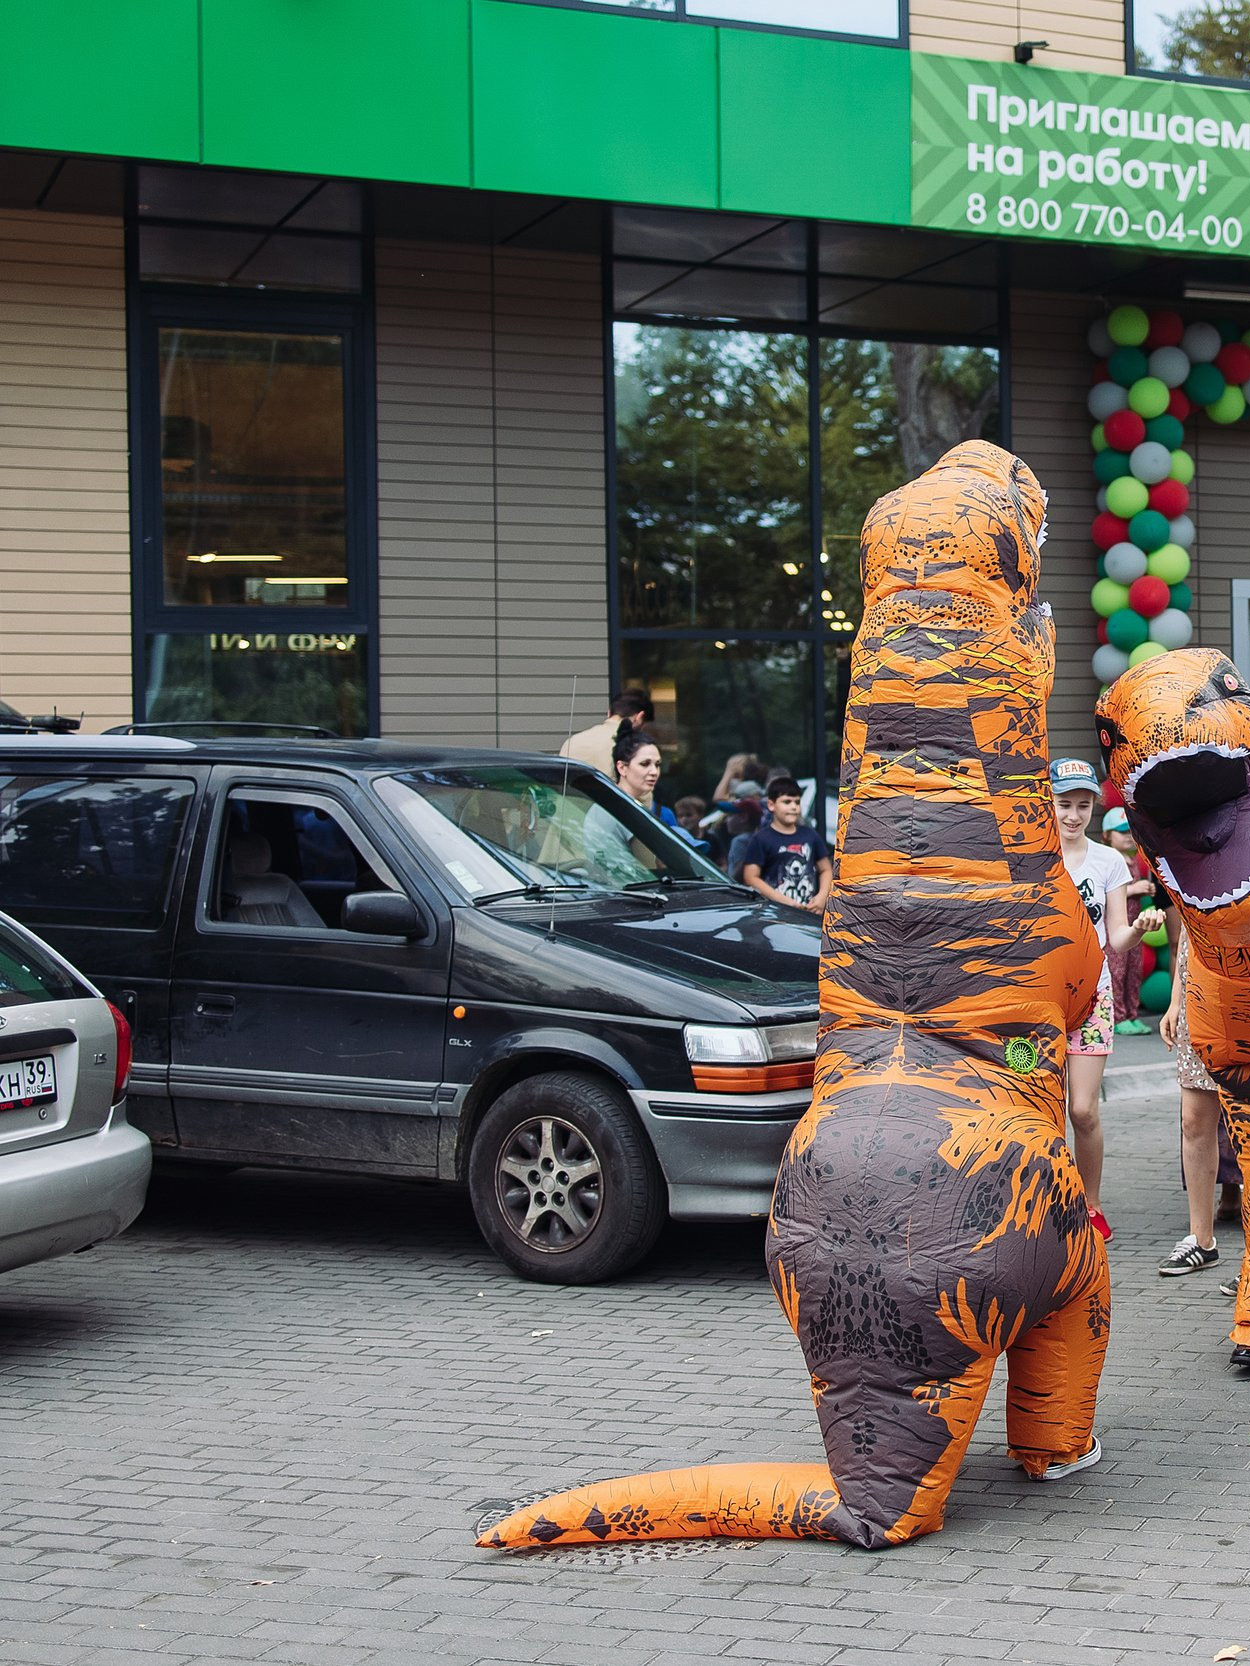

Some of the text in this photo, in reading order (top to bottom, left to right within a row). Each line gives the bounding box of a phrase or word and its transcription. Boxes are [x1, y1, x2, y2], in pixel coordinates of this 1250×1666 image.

[967, 142, 1208, 202] на работу!
[966, 192, 1243, 248] 8 800 770-04-00
[1058, 763, 1091, 776] JEANS
[448, 1038, 473, 1048] GLX
[25, 1060, 47, 1085] 39
[26, 1084, 42, 1096] RUS
